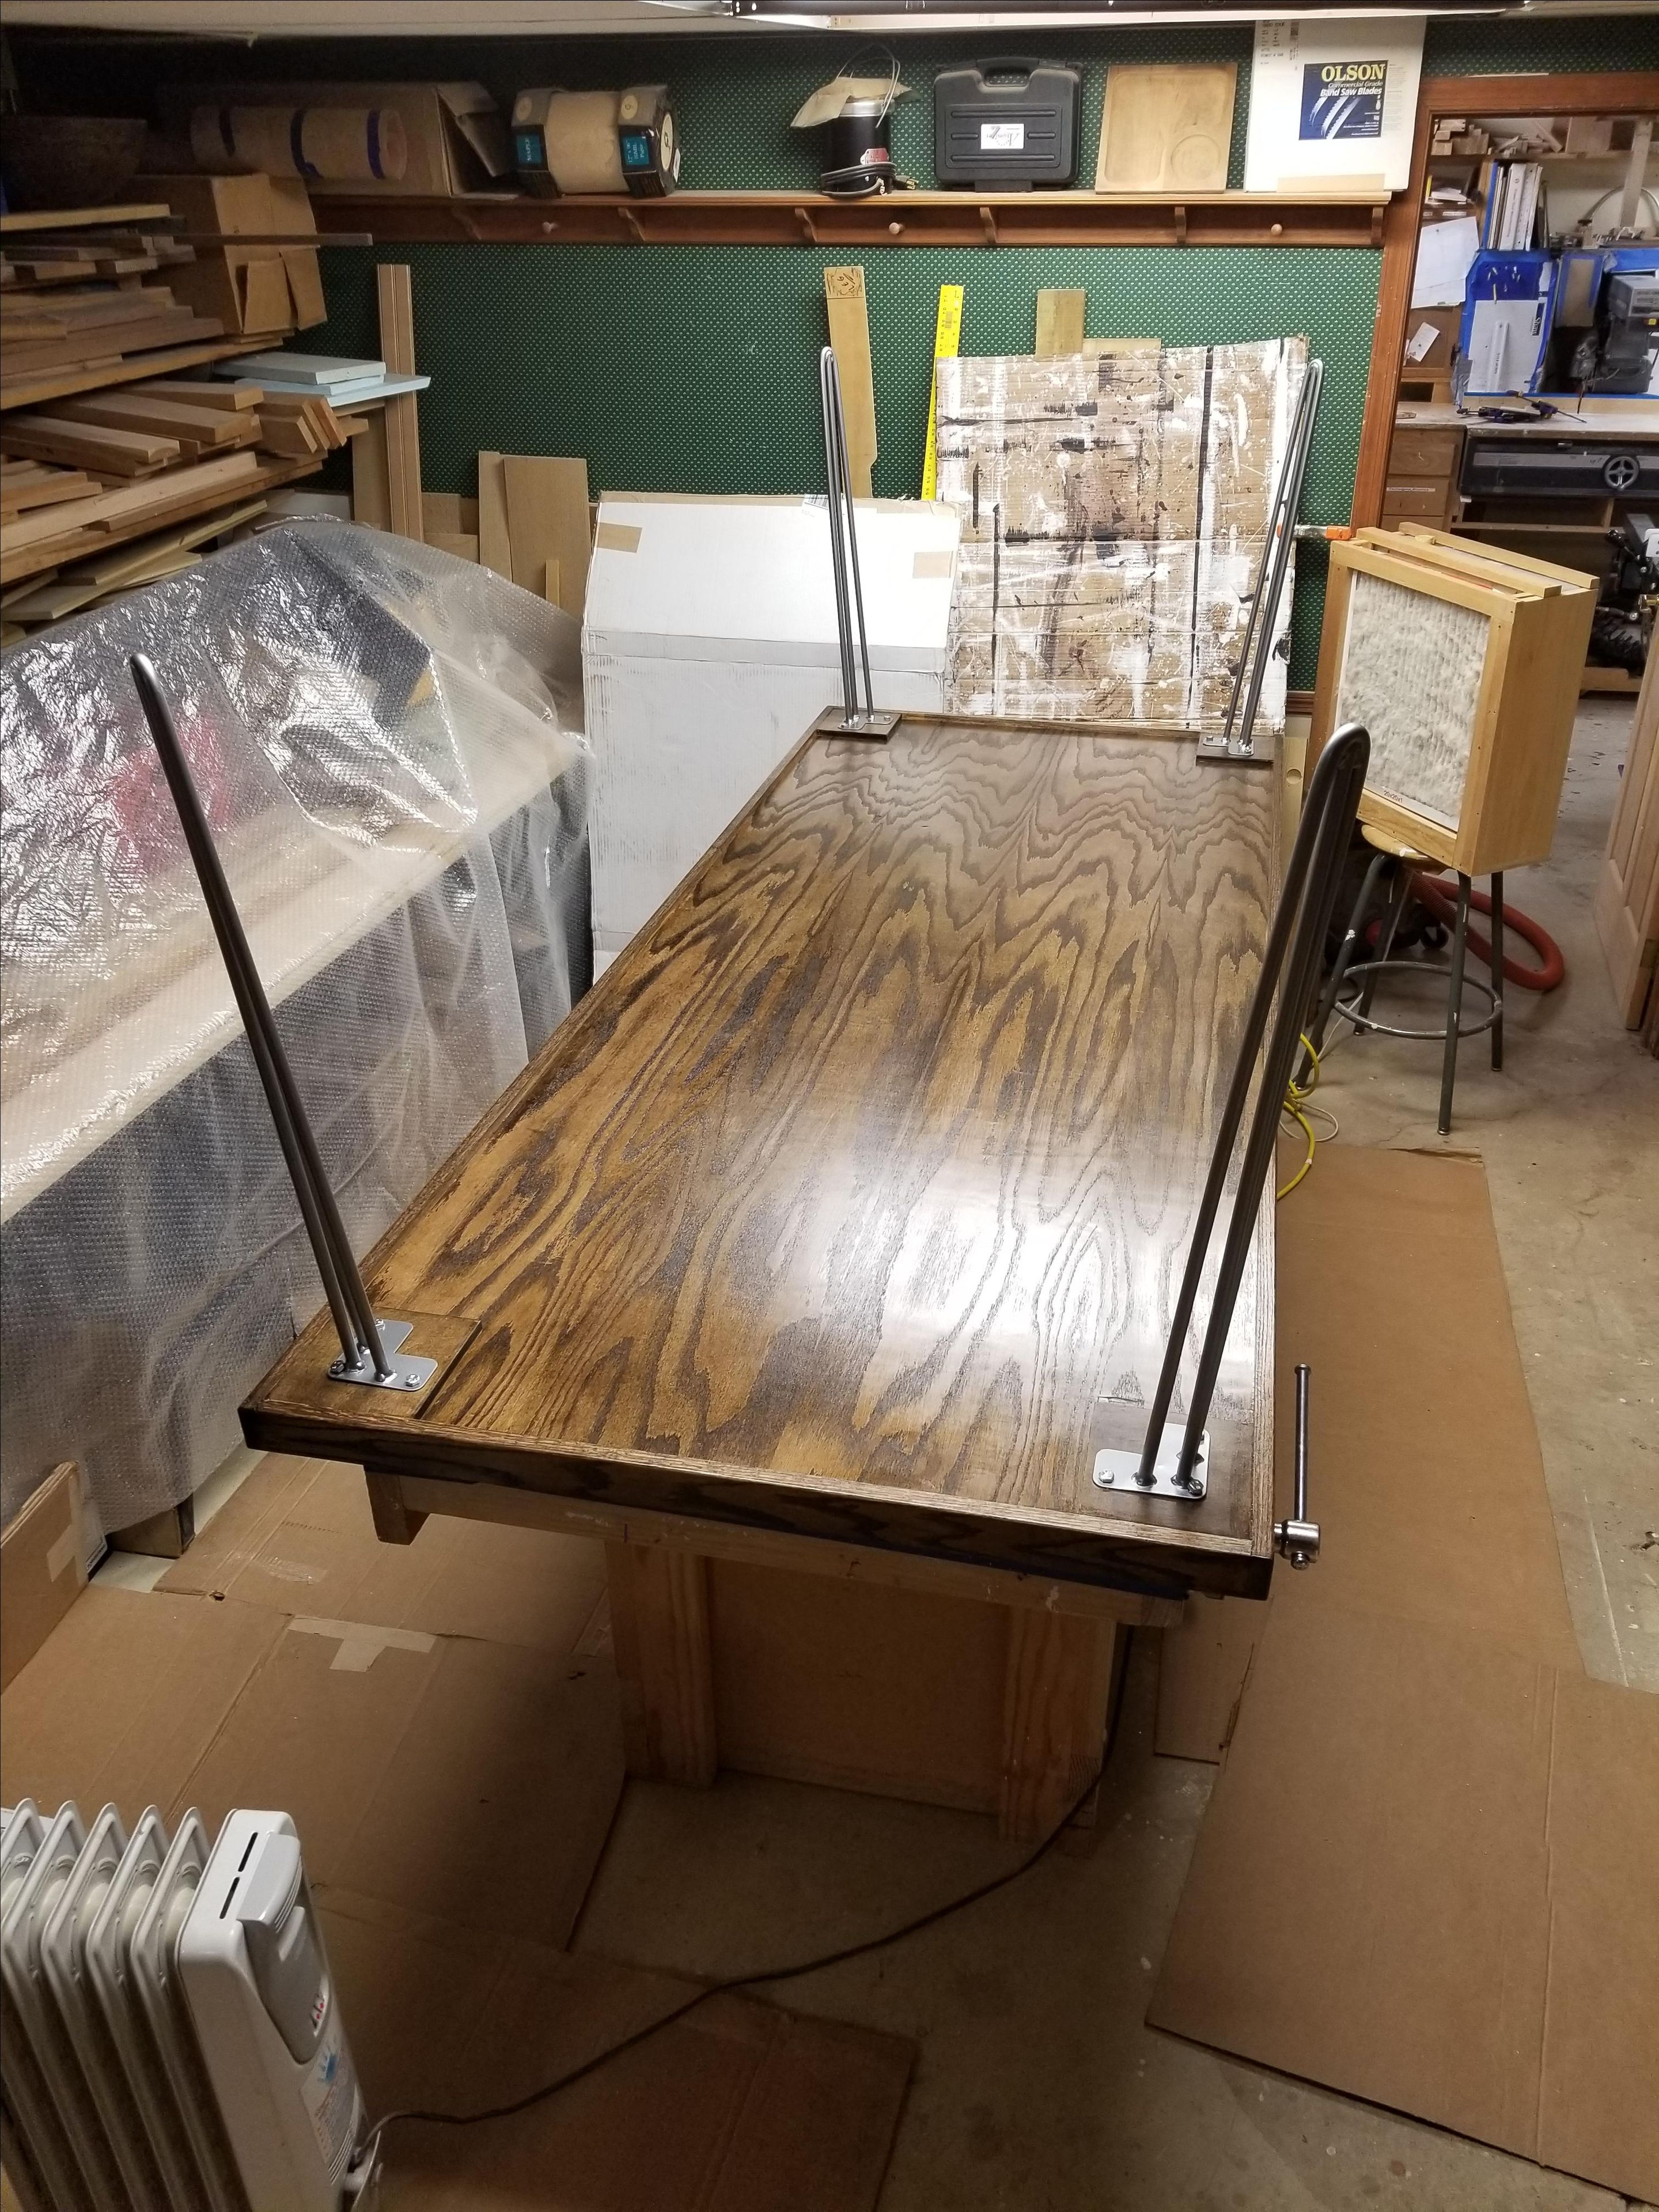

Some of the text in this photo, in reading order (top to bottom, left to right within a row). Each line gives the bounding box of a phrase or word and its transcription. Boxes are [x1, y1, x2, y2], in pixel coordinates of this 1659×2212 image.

[1321, 64, 1385, 82] OLSON
[1320, 88, 1339, 96] Band
[1357, 87, 1382, 95] Blades
